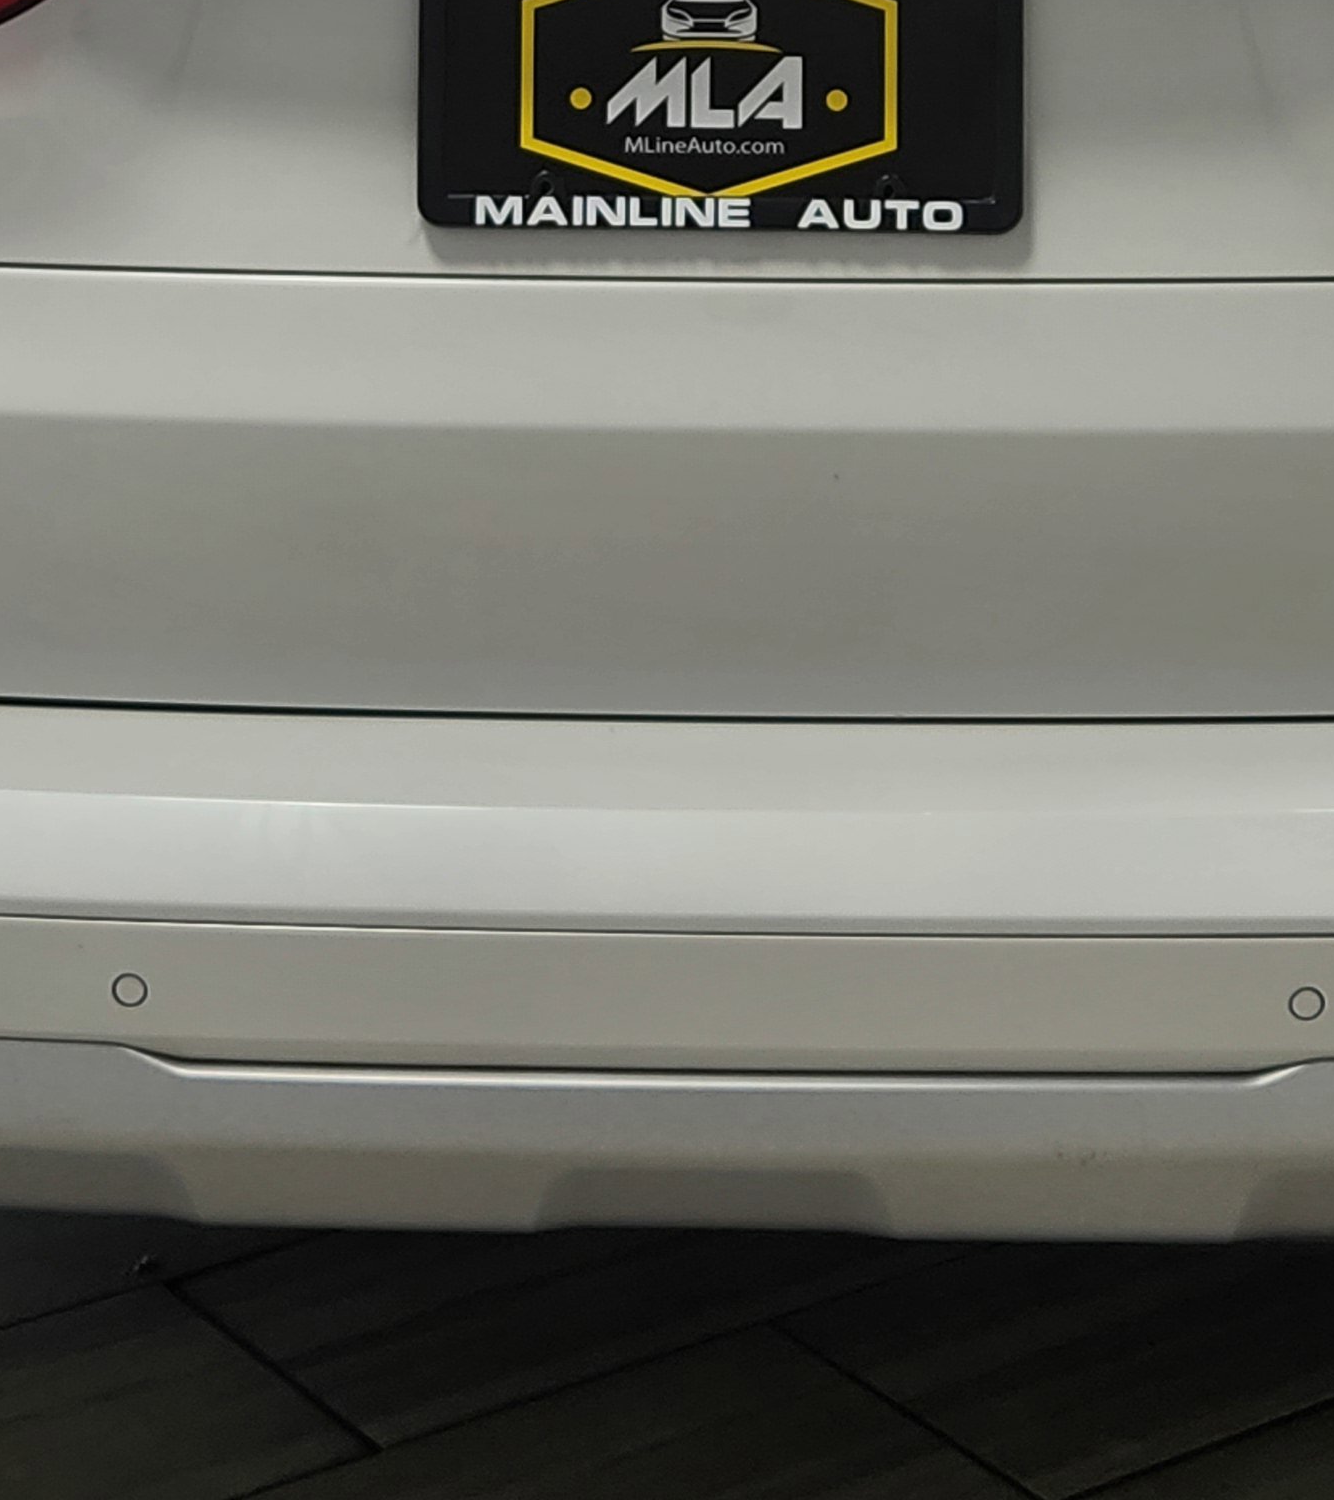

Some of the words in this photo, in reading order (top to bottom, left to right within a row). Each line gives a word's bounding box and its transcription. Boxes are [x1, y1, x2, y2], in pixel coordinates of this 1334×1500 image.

[606, 55, 804, 130] MLA
[624, 136, 786, 156] MLineAuto.com
[474, 195, 752, 229] MAINLINE
[798, 200, 964, 232] AUTO
